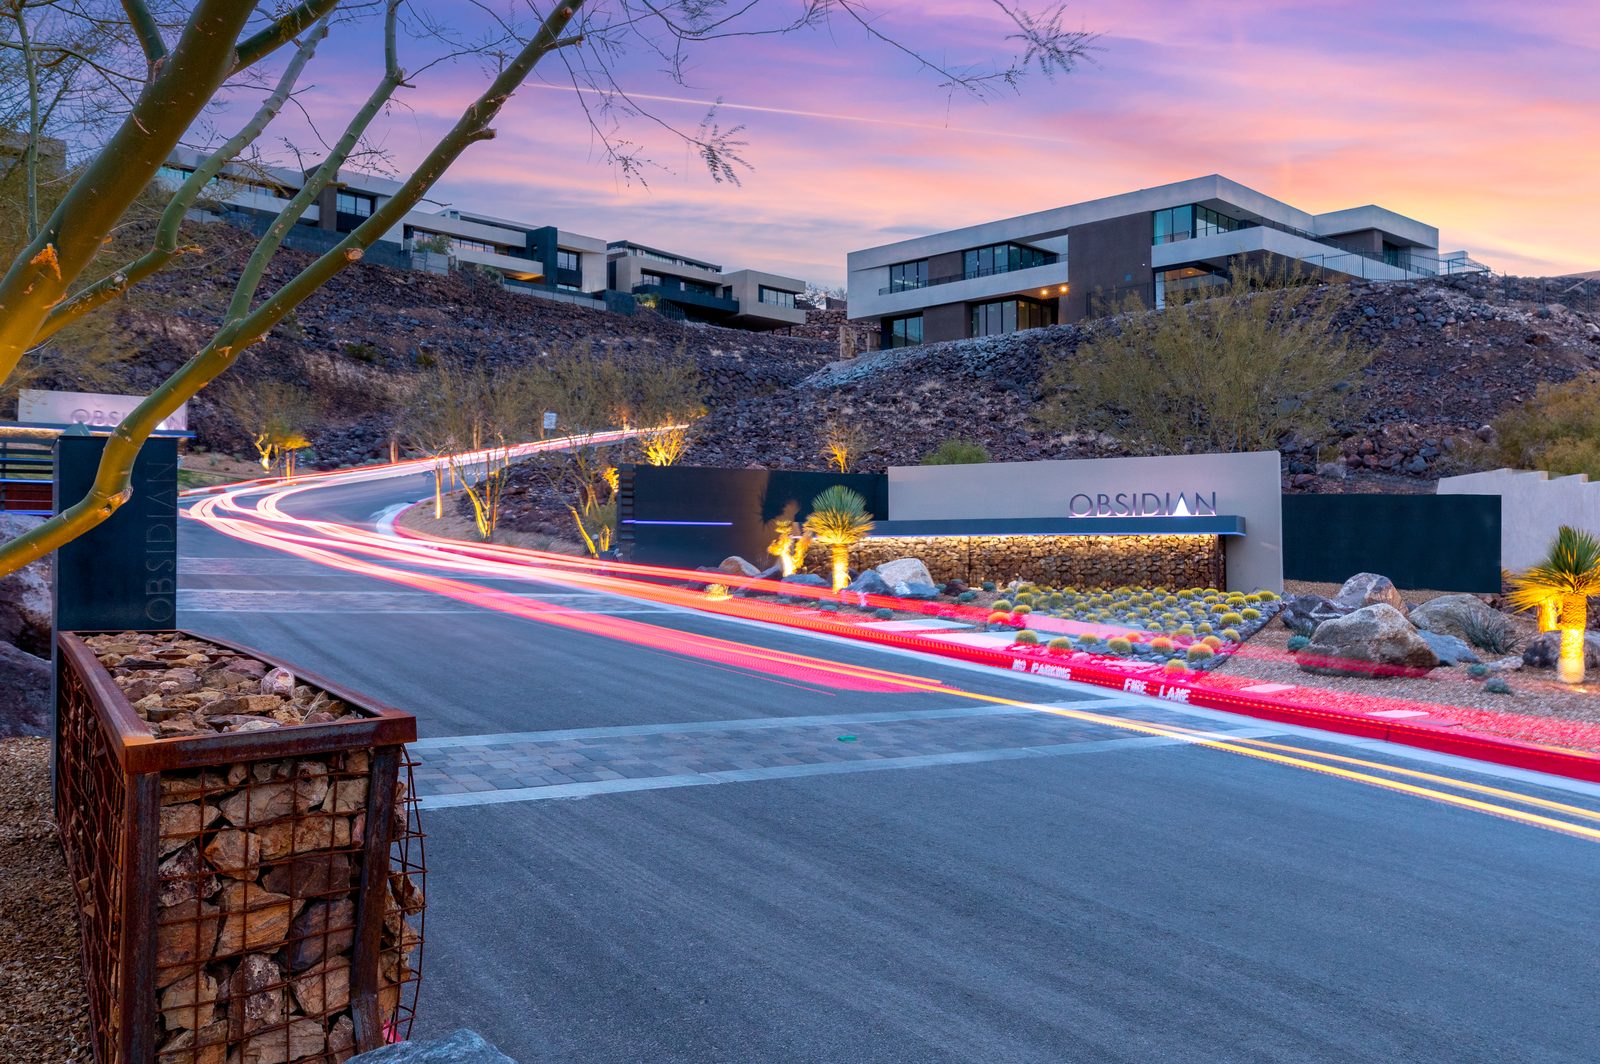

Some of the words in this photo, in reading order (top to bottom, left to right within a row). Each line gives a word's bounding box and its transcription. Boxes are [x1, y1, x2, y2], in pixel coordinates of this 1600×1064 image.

[1069, 491, 1216, 517] OBSIDIAN
[145, 461, 176, 622] OBSIDIAN
[1012, 659, 1026, 671] NO
[1031, 662, 1071, 680] PARKING
[1123, 678, 1148, 694] FIRE
[1158, 685, 1191, 704] LANE
